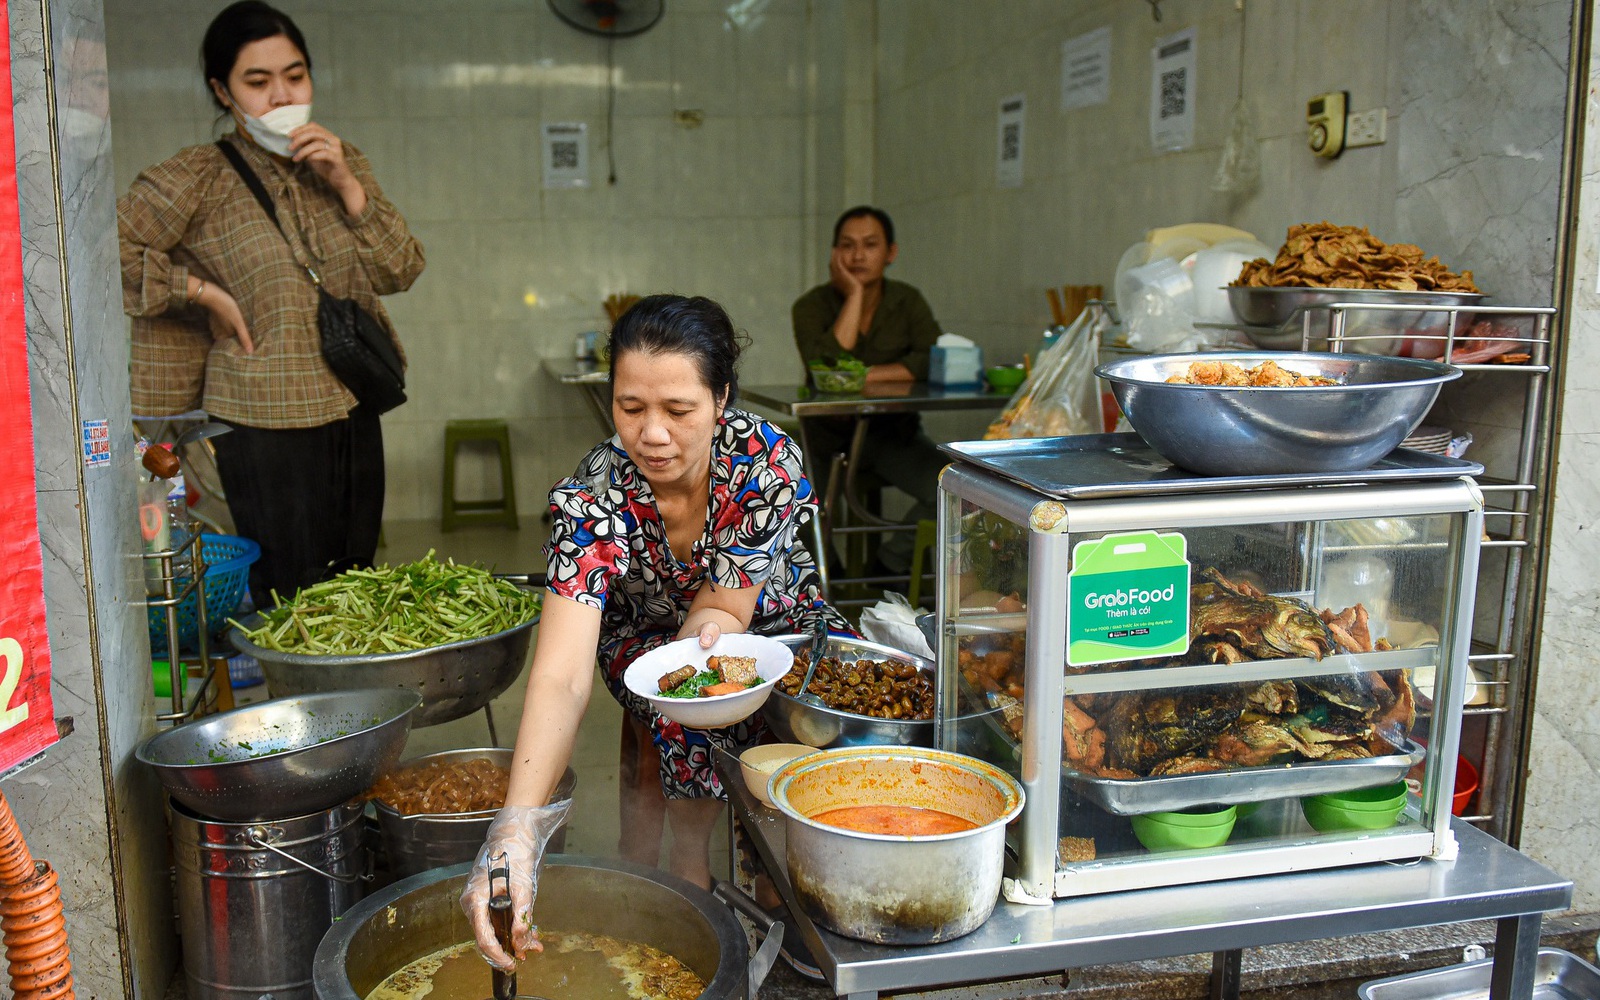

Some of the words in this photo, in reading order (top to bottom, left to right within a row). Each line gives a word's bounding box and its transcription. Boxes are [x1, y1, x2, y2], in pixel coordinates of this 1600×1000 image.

[1085, 584, 1174, 609] GrabFood
[1106, 608, 1128, 618] Thèm
[1130, 607, 1137, 616] là
[1139, 606, 1151, 615] có!
